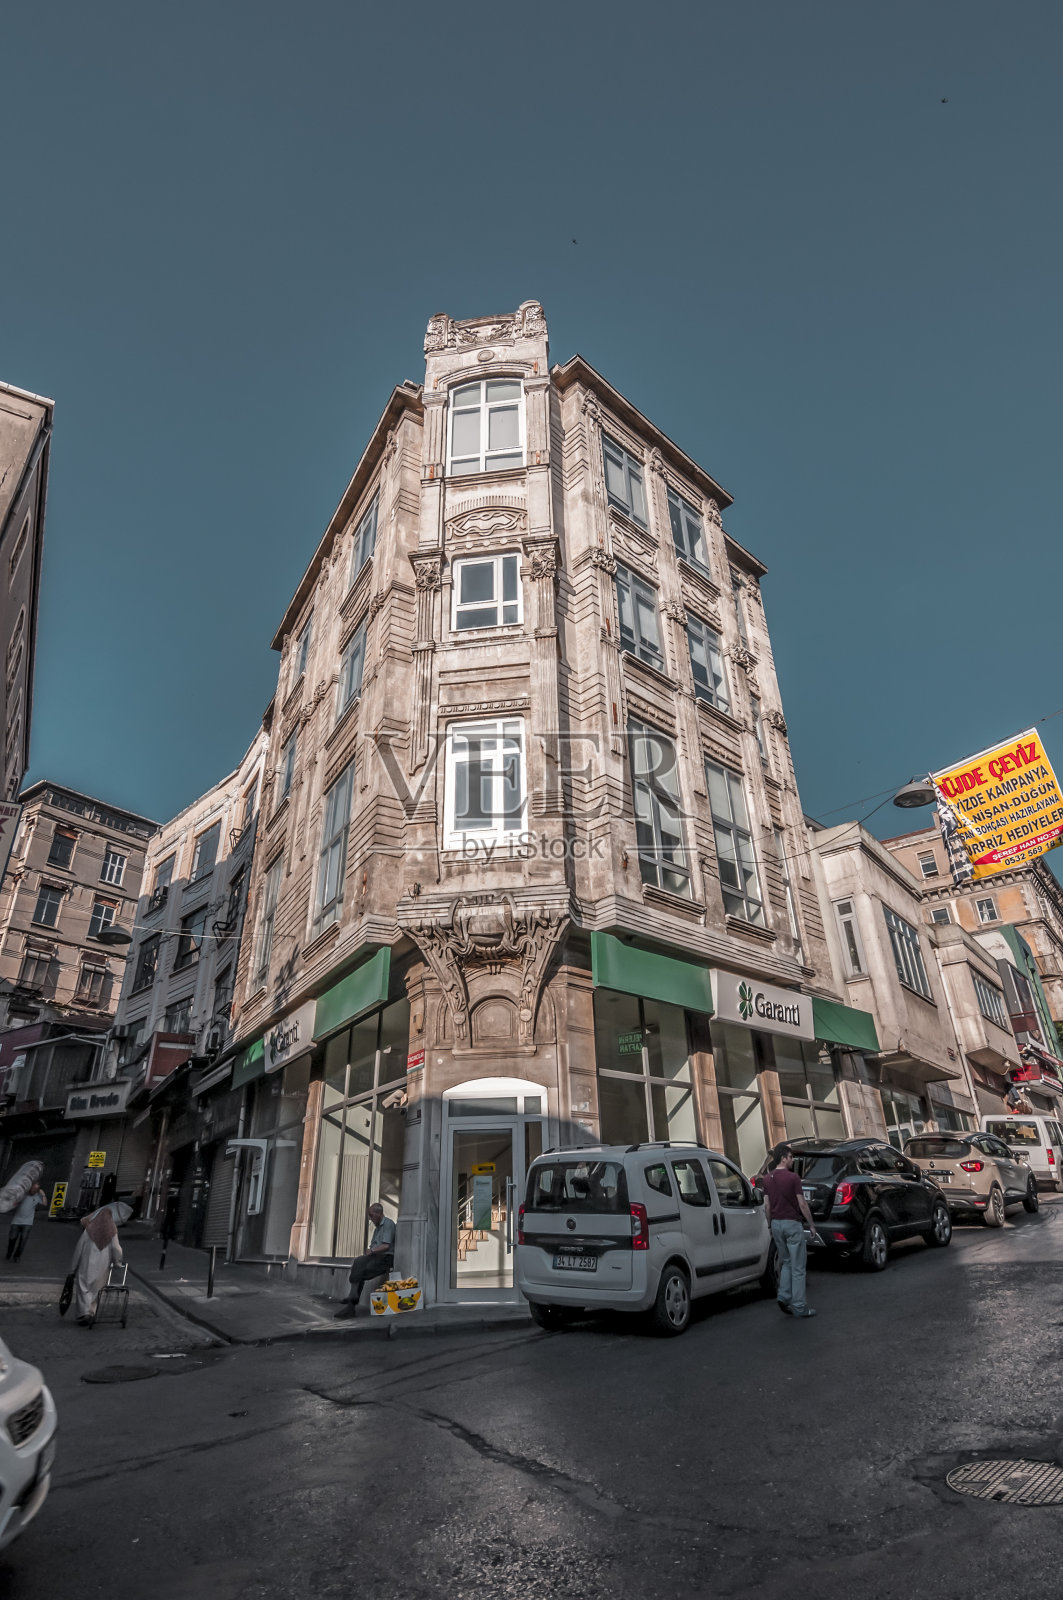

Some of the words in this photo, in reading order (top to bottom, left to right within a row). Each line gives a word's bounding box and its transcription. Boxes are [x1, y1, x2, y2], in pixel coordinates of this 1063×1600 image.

[938, 767, 988, 799] ÜJDE
[988, 741, 1041, 782] ÇEYİZ
[985, 764, 1049, 801] KAMPANYA
[1008, 793, 1060, 823] HAZIRLAYANA
[1005, 853, 1026, 866] 0532
[1028, 845, 1043, 857] 569
[1019, 839, 1037, 850] HAN
[754, 992, 801, 1026] Garanti
[276, 1020, 300, 1053] Garanti
[557, 1255, 565, 1266] 34
[567, 1257, 576, 1266] LT
